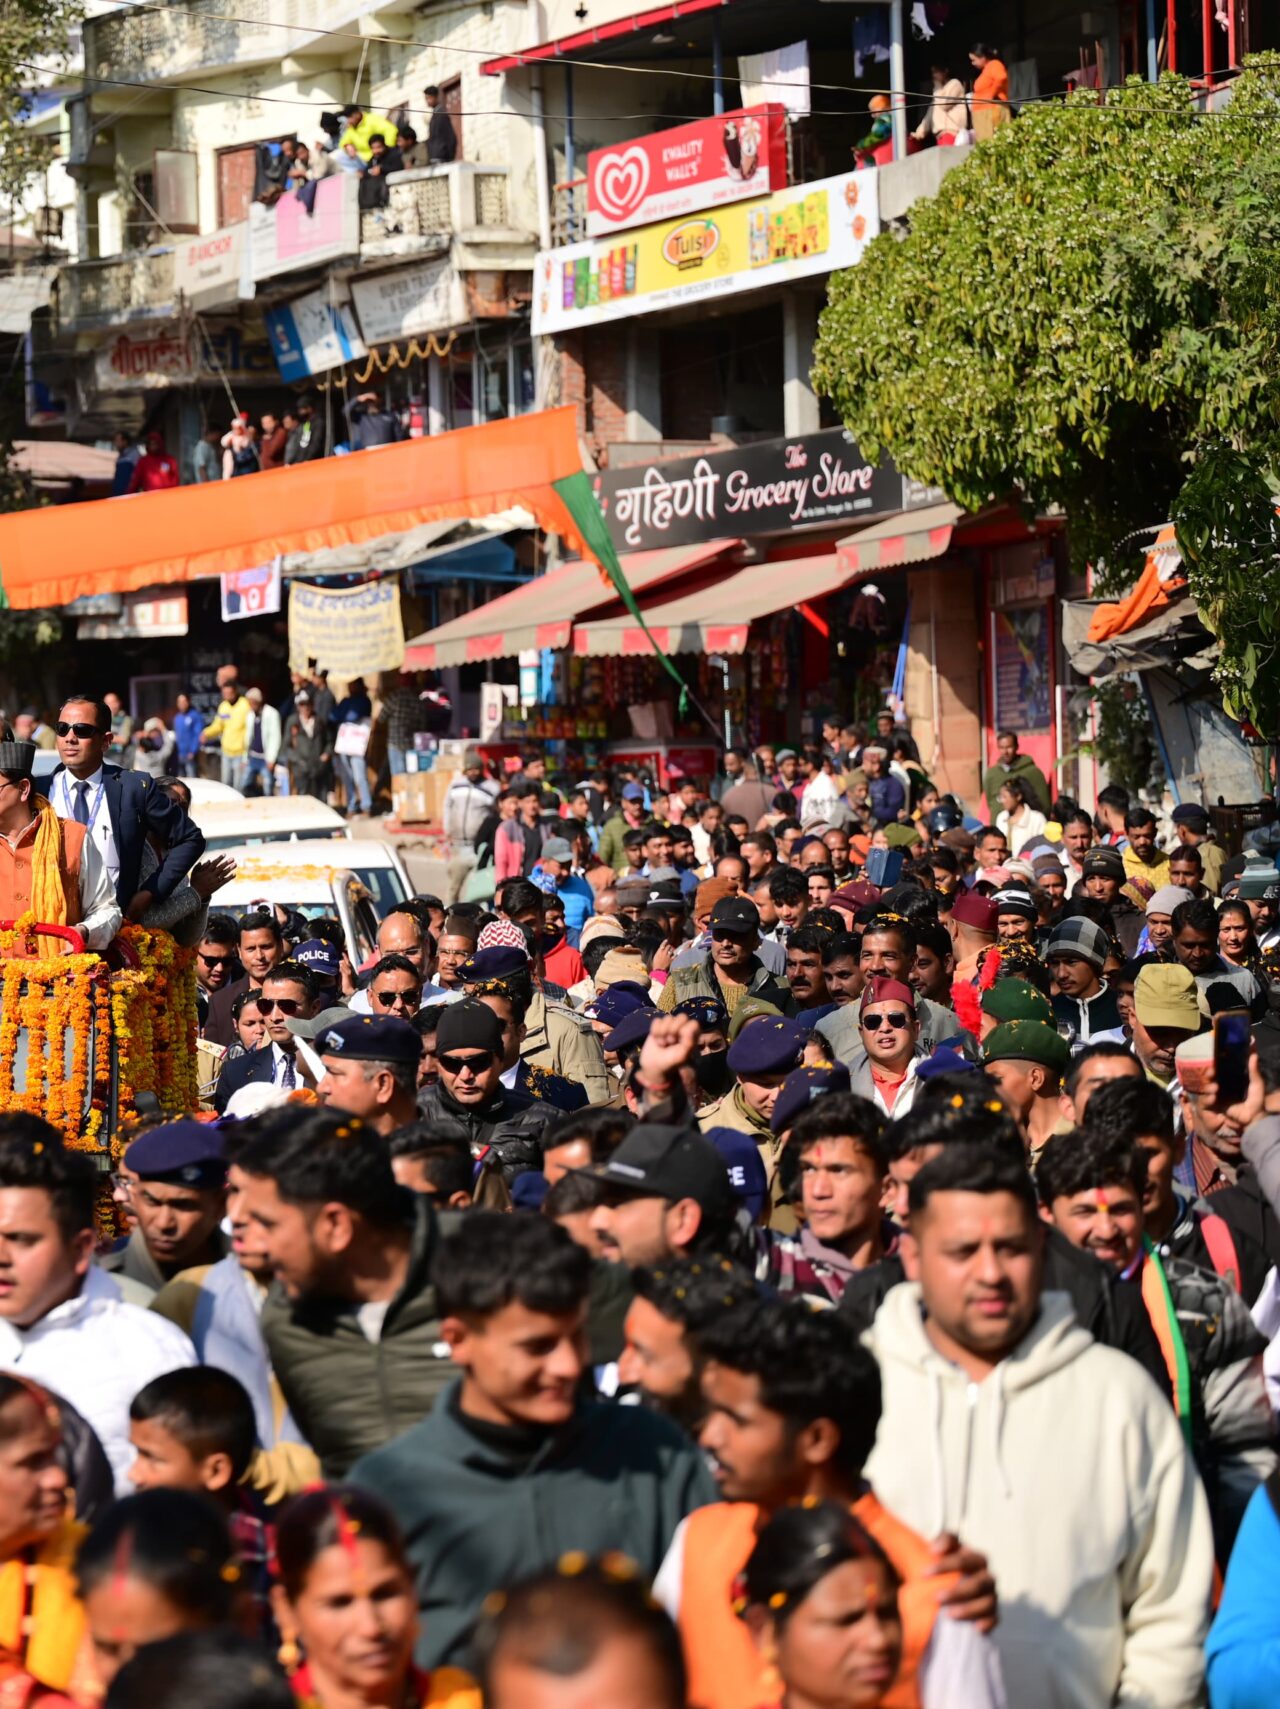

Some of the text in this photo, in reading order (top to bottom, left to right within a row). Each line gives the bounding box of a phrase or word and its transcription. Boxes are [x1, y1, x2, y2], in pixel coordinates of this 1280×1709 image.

[662, 139, 704, 163] KWALITY
[784, 444, 807, 470] The
[615, 457, 719, 544] गृहिणी
[724, 468, 810, 520] Grocery
[812, 451, 873, 499] Store
[298, 950, 329, 963] POLICE
